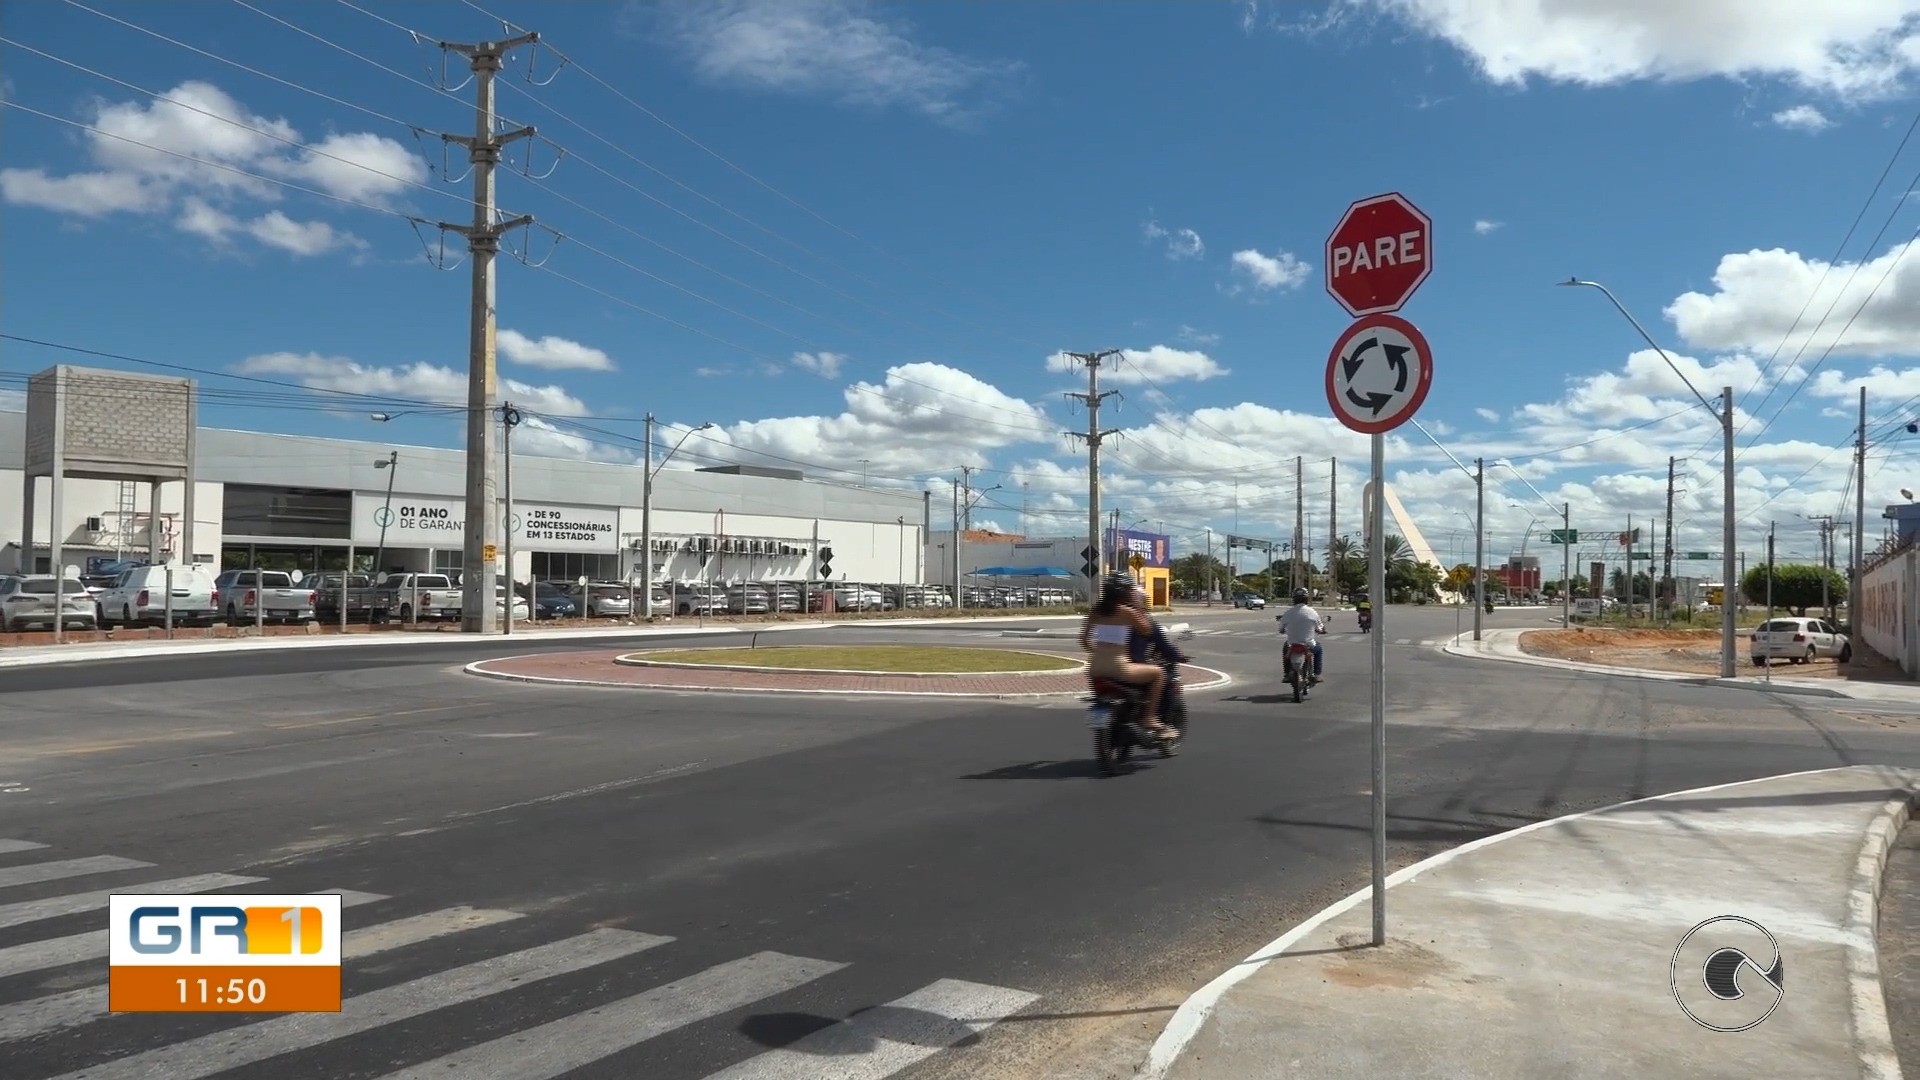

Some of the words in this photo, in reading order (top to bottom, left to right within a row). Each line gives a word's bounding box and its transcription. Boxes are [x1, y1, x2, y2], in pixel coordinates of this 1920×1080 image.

[1333, 230, 1422, 278] PARE
[400, 506, 415, 517] 01
[419, 507, 449, 519] ANO
[534, 510, 547, 519] DE
[549, 511, 561, 520] 90
[400, 518, 415, 529] DE
[526, 520, 612, 532] CONCESSIONÁRIAS
[526, 530, 541, 539] EM
[543, 531, 553, 539] 13
[555, 531, 596, 541] ESTADOS
